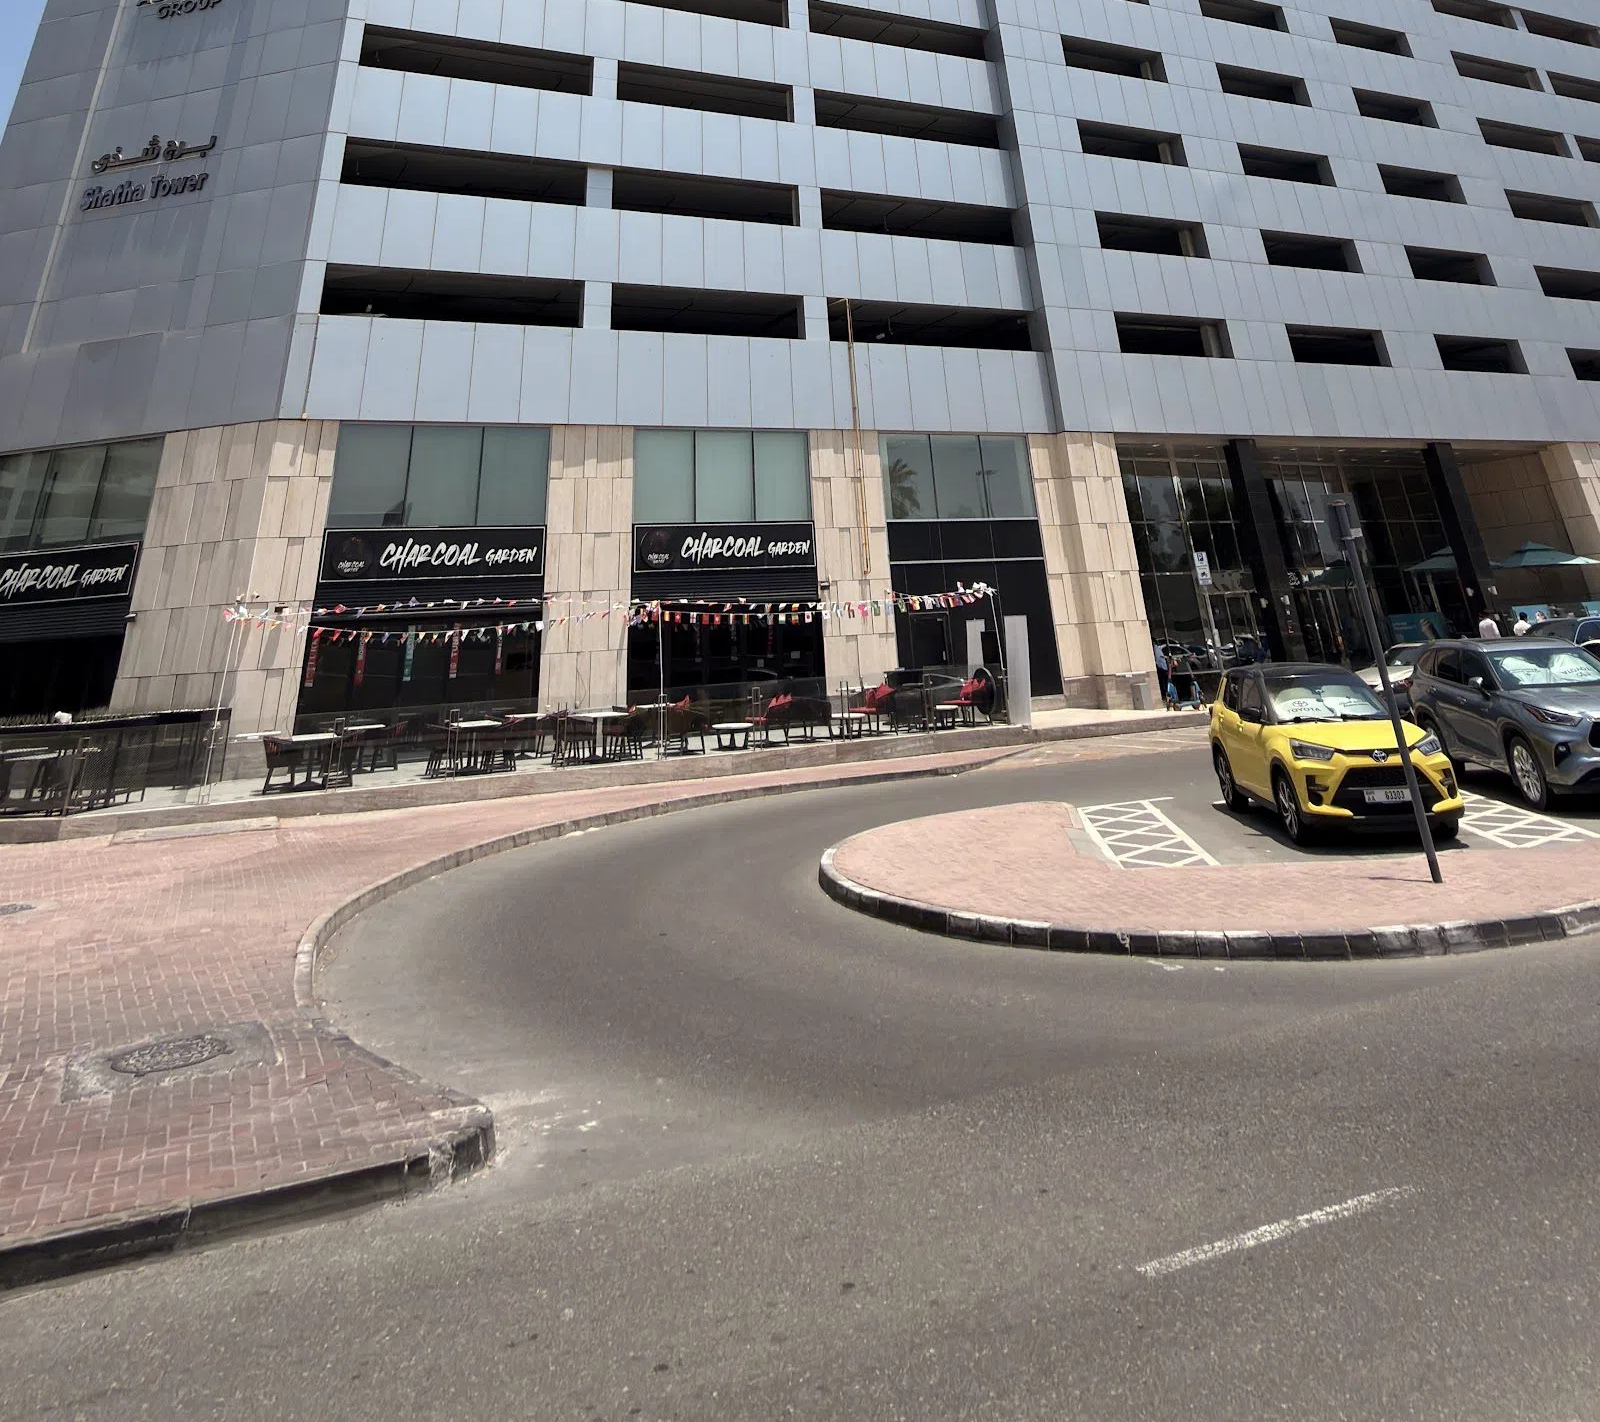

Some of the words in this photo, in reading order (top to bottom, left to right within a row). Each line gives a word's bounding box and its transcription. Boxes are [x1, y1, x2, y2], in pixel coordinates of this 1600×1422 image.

[80, 180, 146, 211] Shatha
[150, 172, 209, 199] Tower
[379, 537, 482, 575] CHARCOAL
[485, 546, 537, 567] GARDEN
[680, 531, 766, 566] CHARCOAL
[767, 539, 811, 559] GARDEN
[0, 562, 81, 599] CHARCOAL
[81, 563, 129, 588] GARDEN
